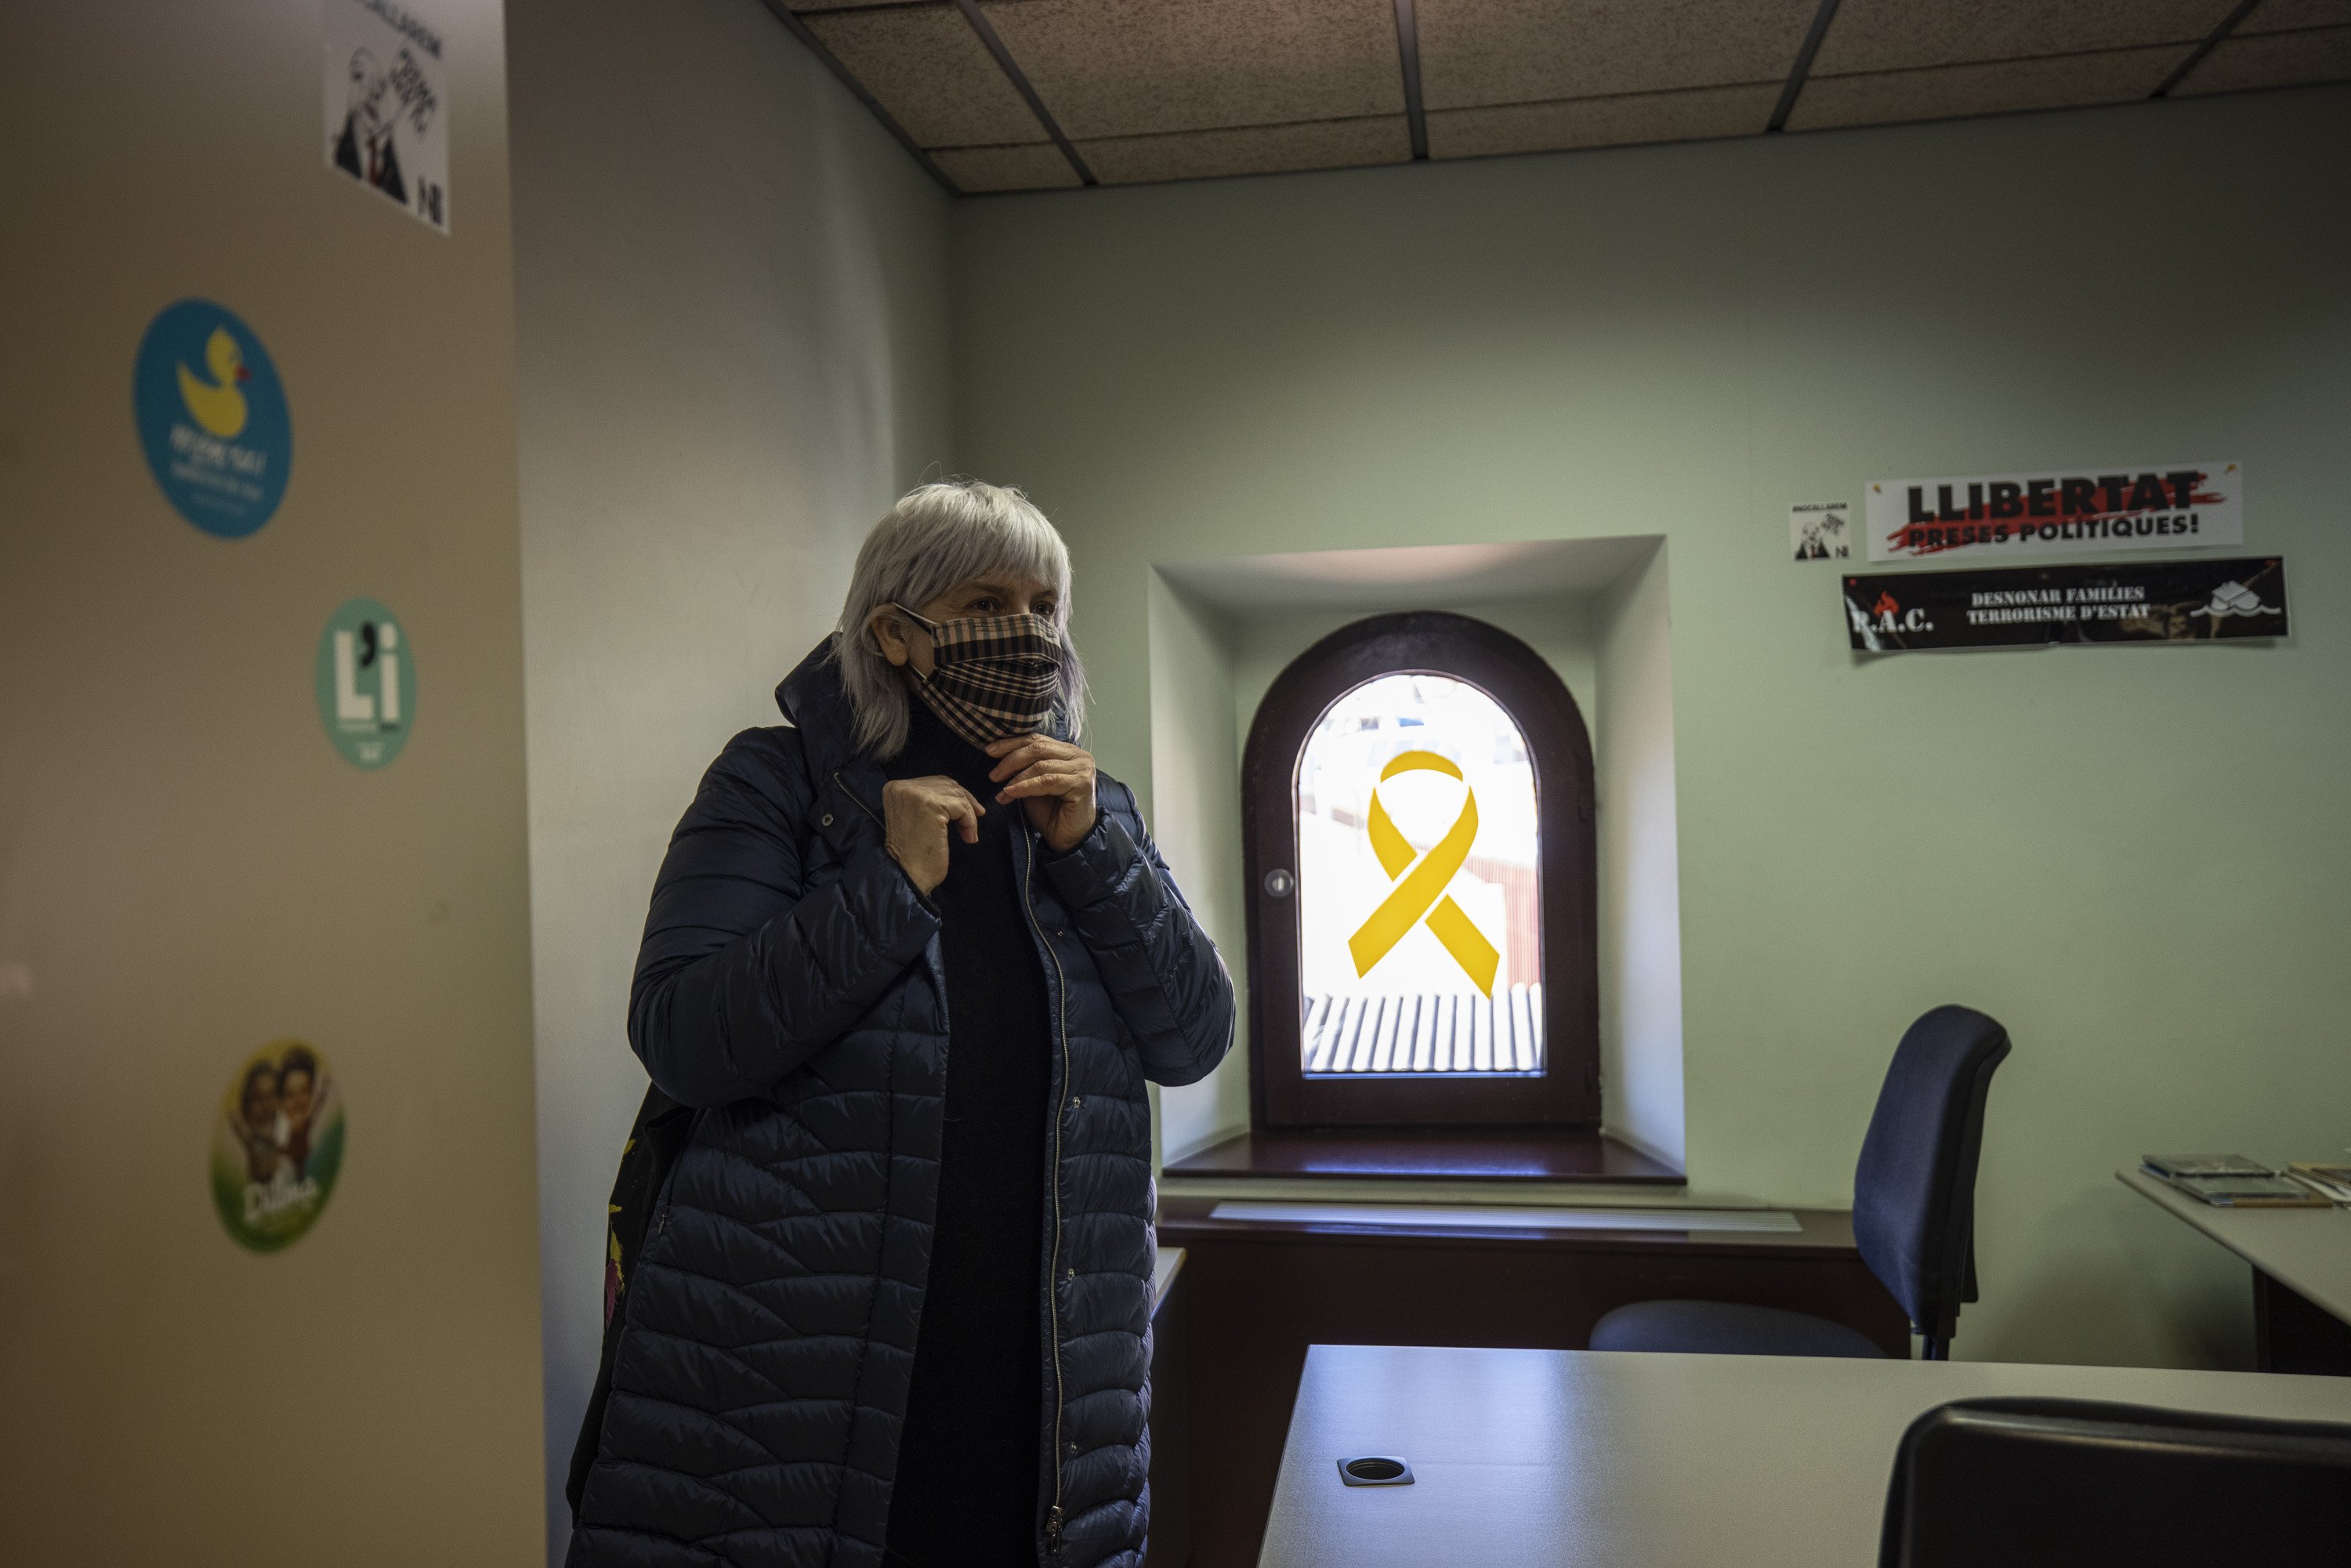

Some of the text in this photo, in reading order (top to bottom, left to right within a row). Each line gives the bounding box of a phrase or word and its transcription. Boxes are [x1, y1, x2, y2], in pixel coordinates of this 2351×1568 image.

[1907, 471, 2199, 523] LLIBERTAT
[1908, 524, 2009, 547] PRESES
[1972, 588, 2062, 607] DESNONAR
[1966, 603, 2150, 625] TERRORISME D'ESTAT
